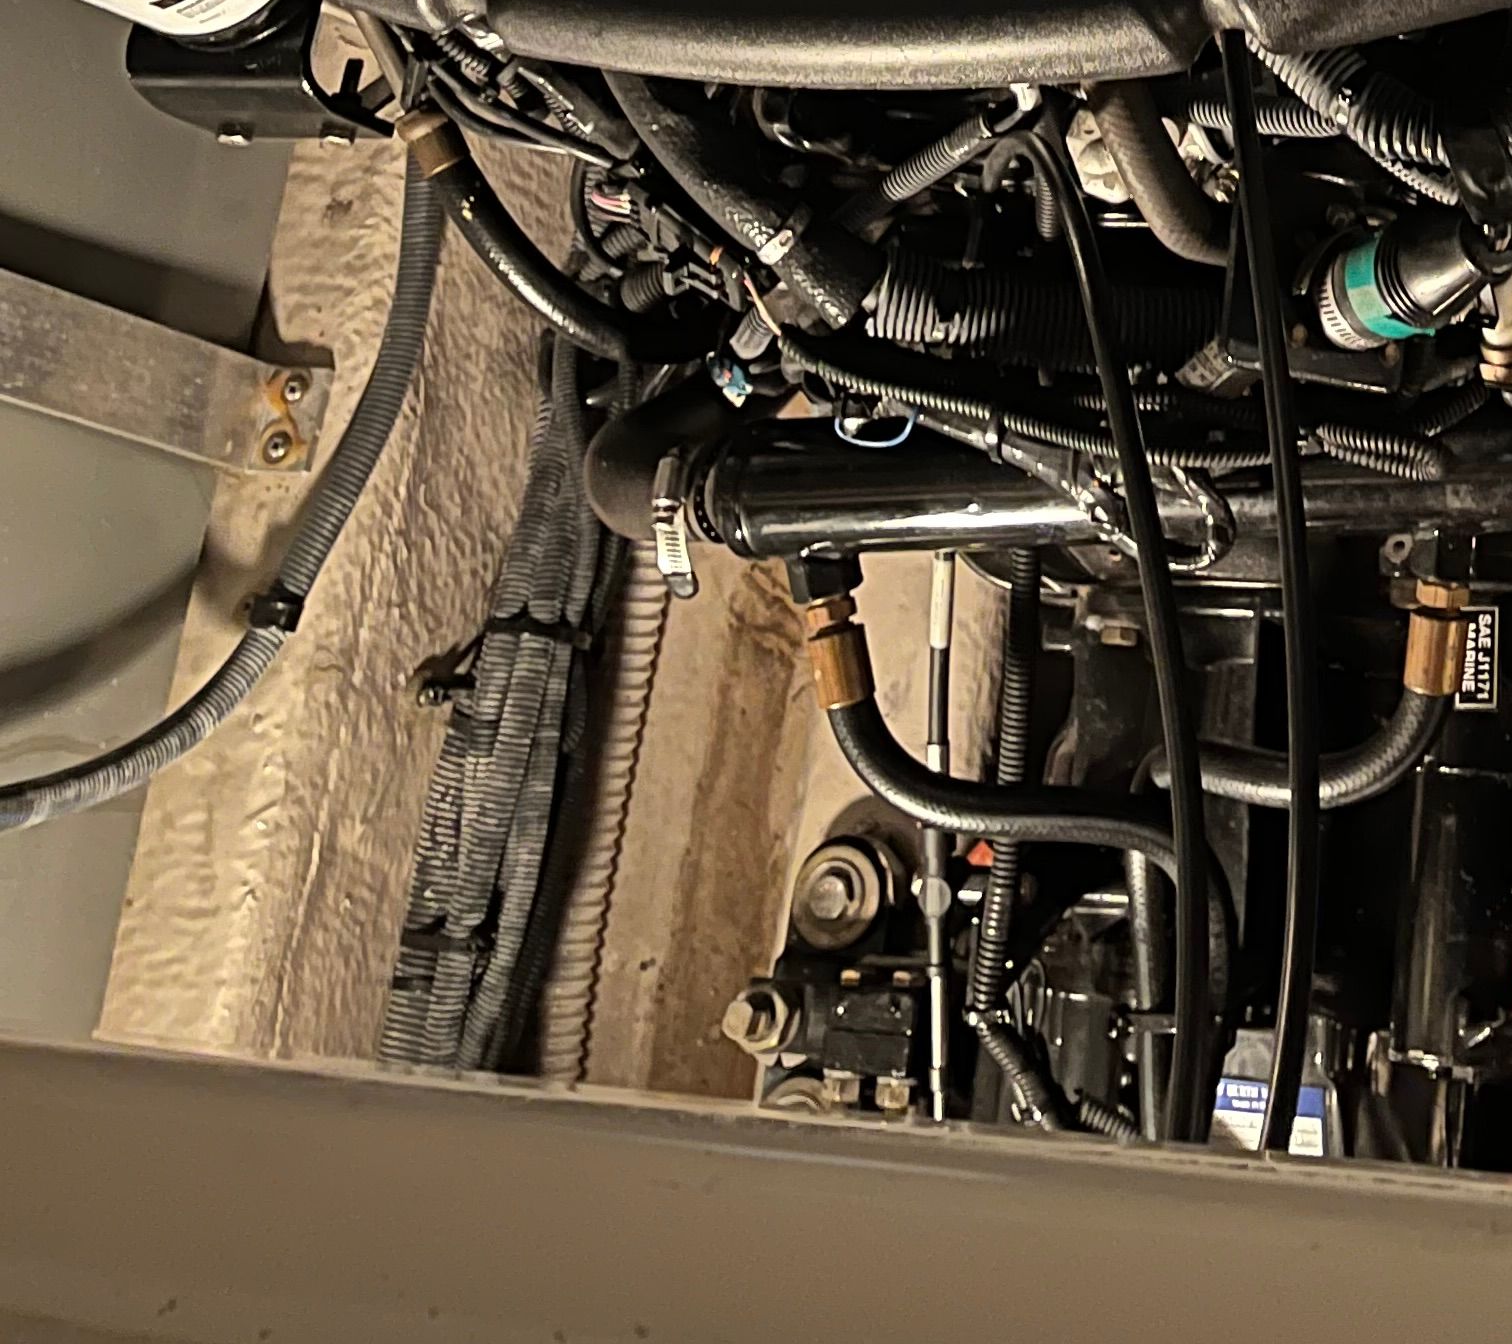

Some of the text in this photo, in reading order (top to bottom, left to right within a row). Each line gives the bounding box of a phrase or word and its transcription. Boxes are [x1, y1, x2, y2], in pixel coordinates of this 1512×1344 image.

[1461, 622, 1476, 692] MARINE
[1476, 613, 1491, 698] SAE J1171
